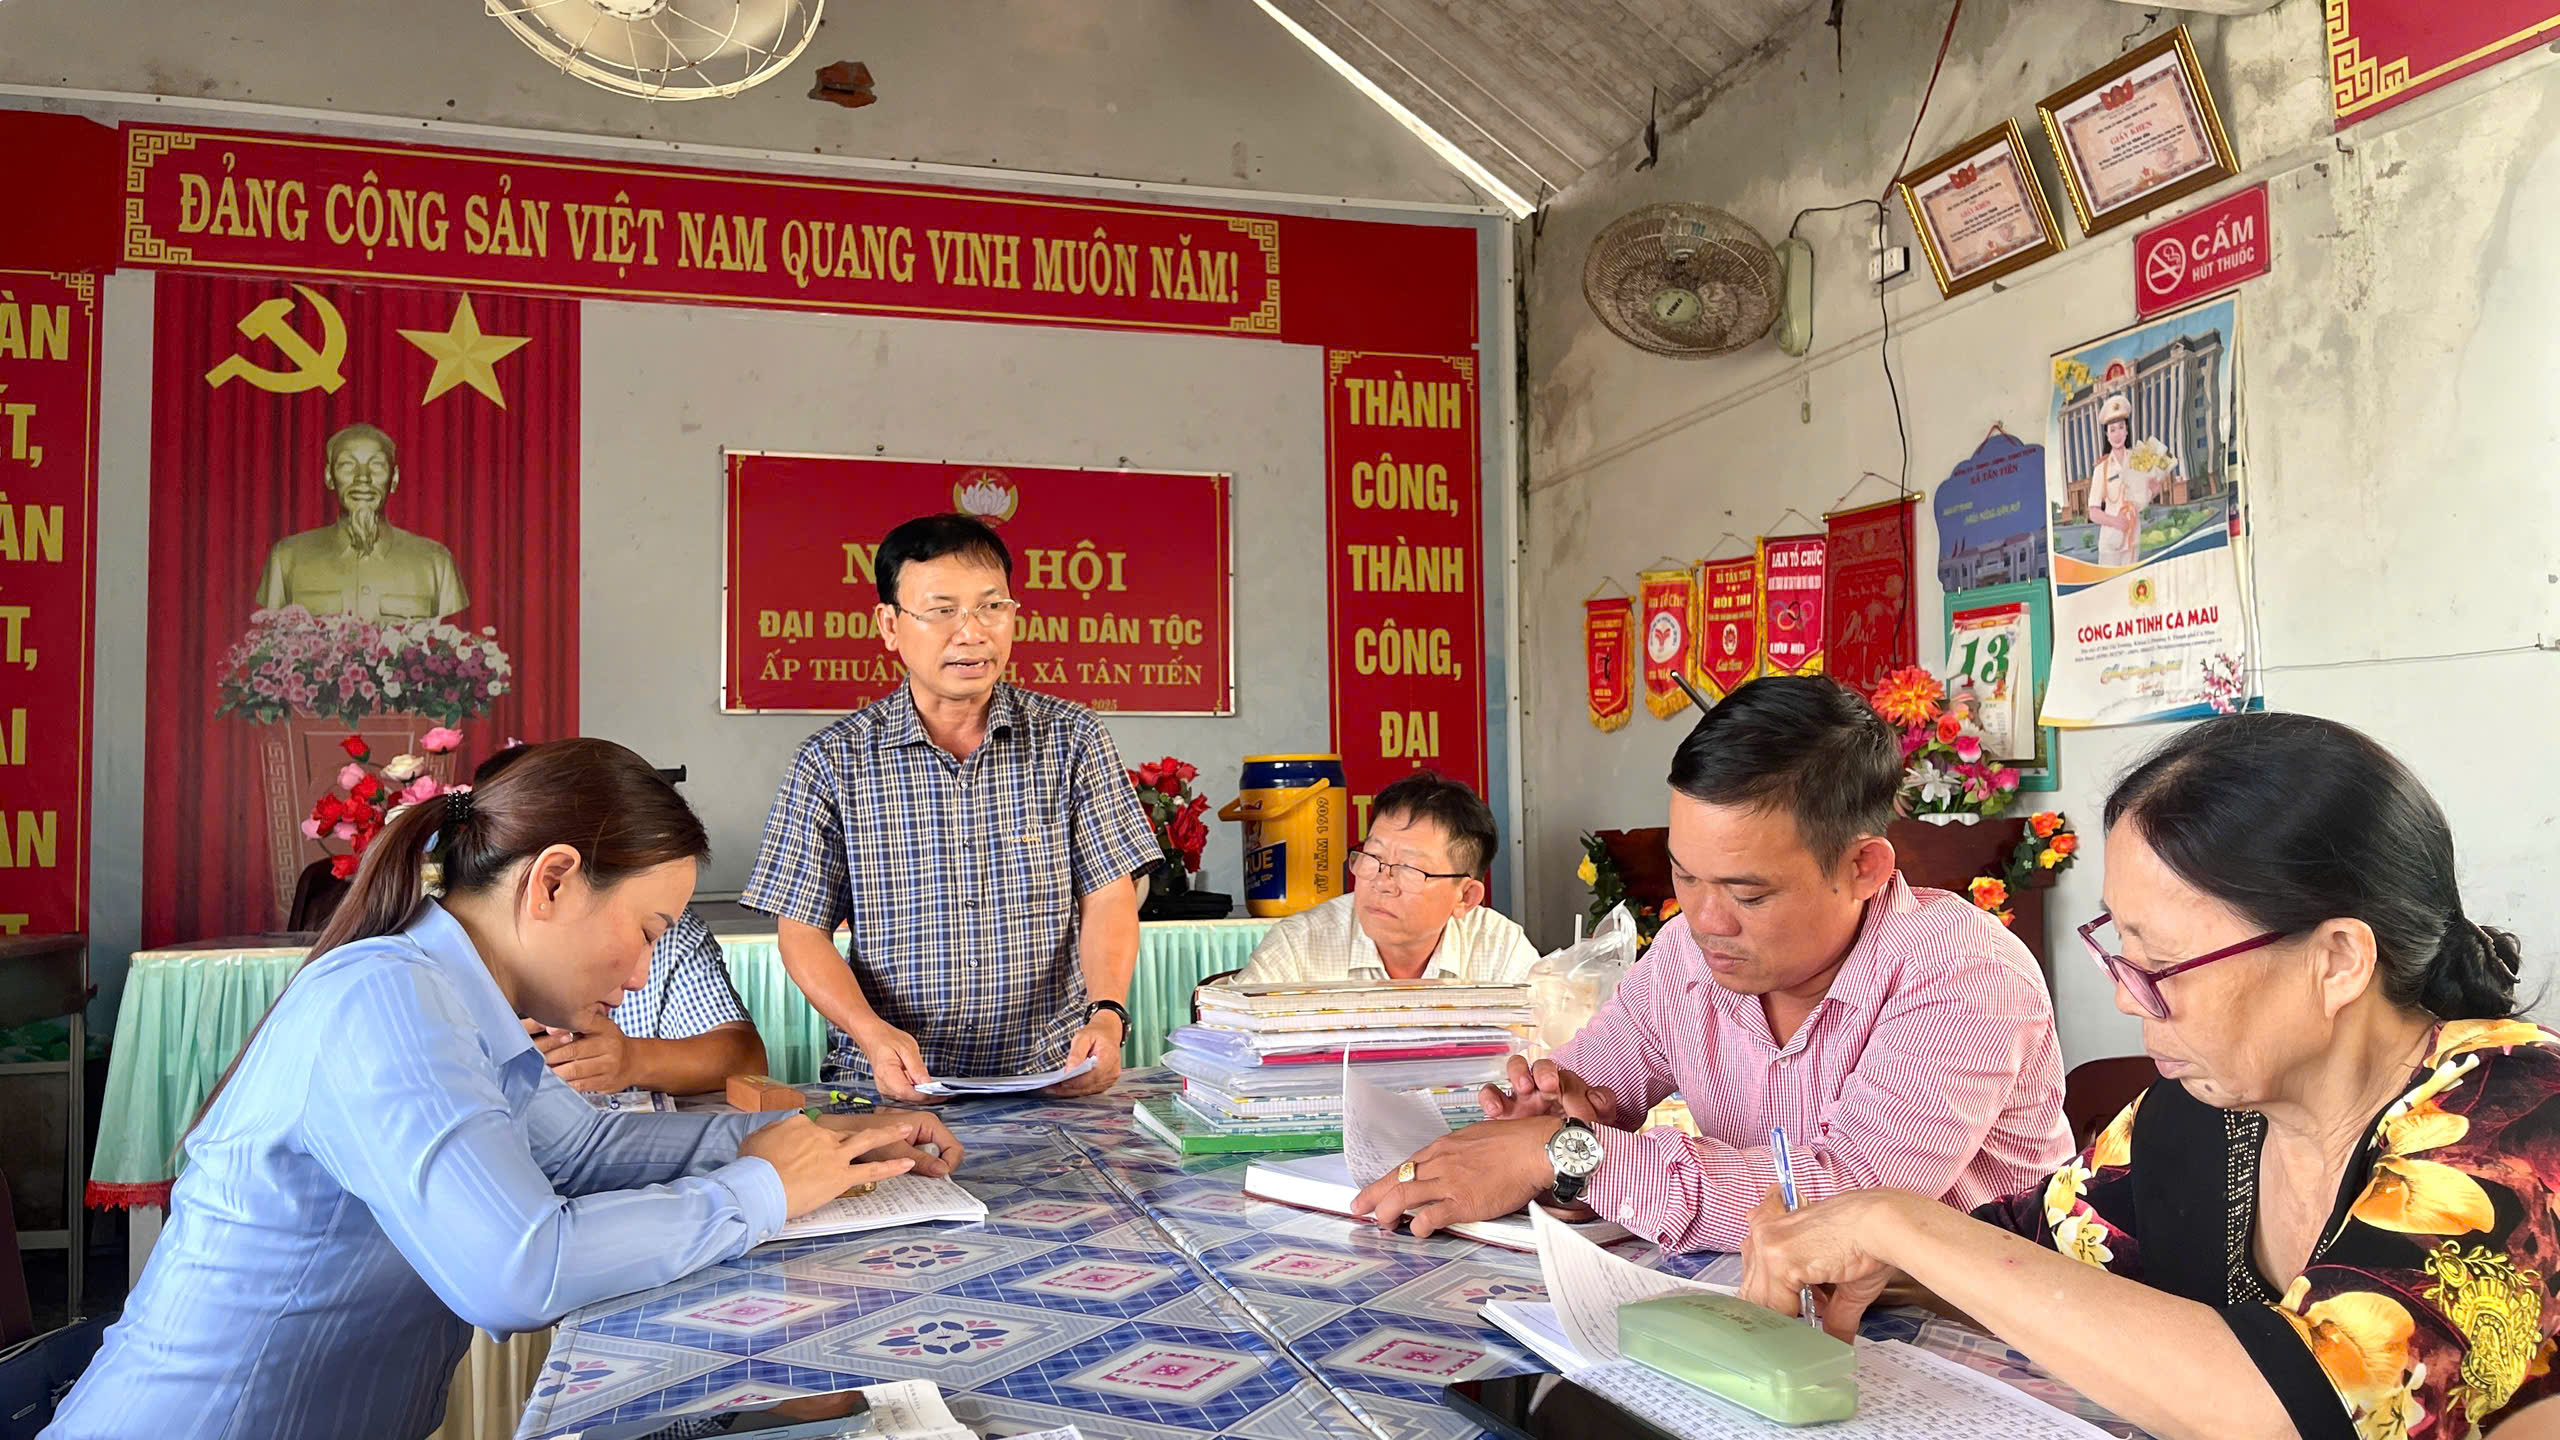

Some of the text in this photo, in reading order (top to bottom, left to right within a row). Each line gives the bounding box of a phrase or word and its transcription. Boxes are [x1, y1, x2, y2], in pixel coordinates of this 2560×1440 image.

[179, 152, 1240, 303] ĐẢNG CỘNG SẢN VIỆT NAM QUANG VINH MUÔN NĂM!
[2191, 213, 2254, 260] CẤM
[2192, 243, 2254, 283] HÚT THUỐC
[0, 385, 42, 468] T,
[1345, 370, 1462, 429] THÀNH
[1351, 452, 1458, 517] CÔNG,
[1024, 539, 1127, 600] HỘI
[1347, 536, 1464, 593] THÀNH
[758, 610, 1203, 650] ĐẠI ĐO OÀN DÂN TỘC
[1354, 618, 1462, 681] CÔNG,
[2115, 620, 2133, 638] AN
[2187, 606, 2219, 627] MAU
[760, 649, 801, 681] ẤP
[1032, 657, 1068, 684] XÃ
[1077, 657, 1132, 685] TÂN
[1138, 655, 1202, 685] TIẾN
[1960, 634, 2009, 687] 13
[1379, 711, 1439, 769] ĐẠI
[1314, 797, 1329, 894] TỪ NĂM 1909
